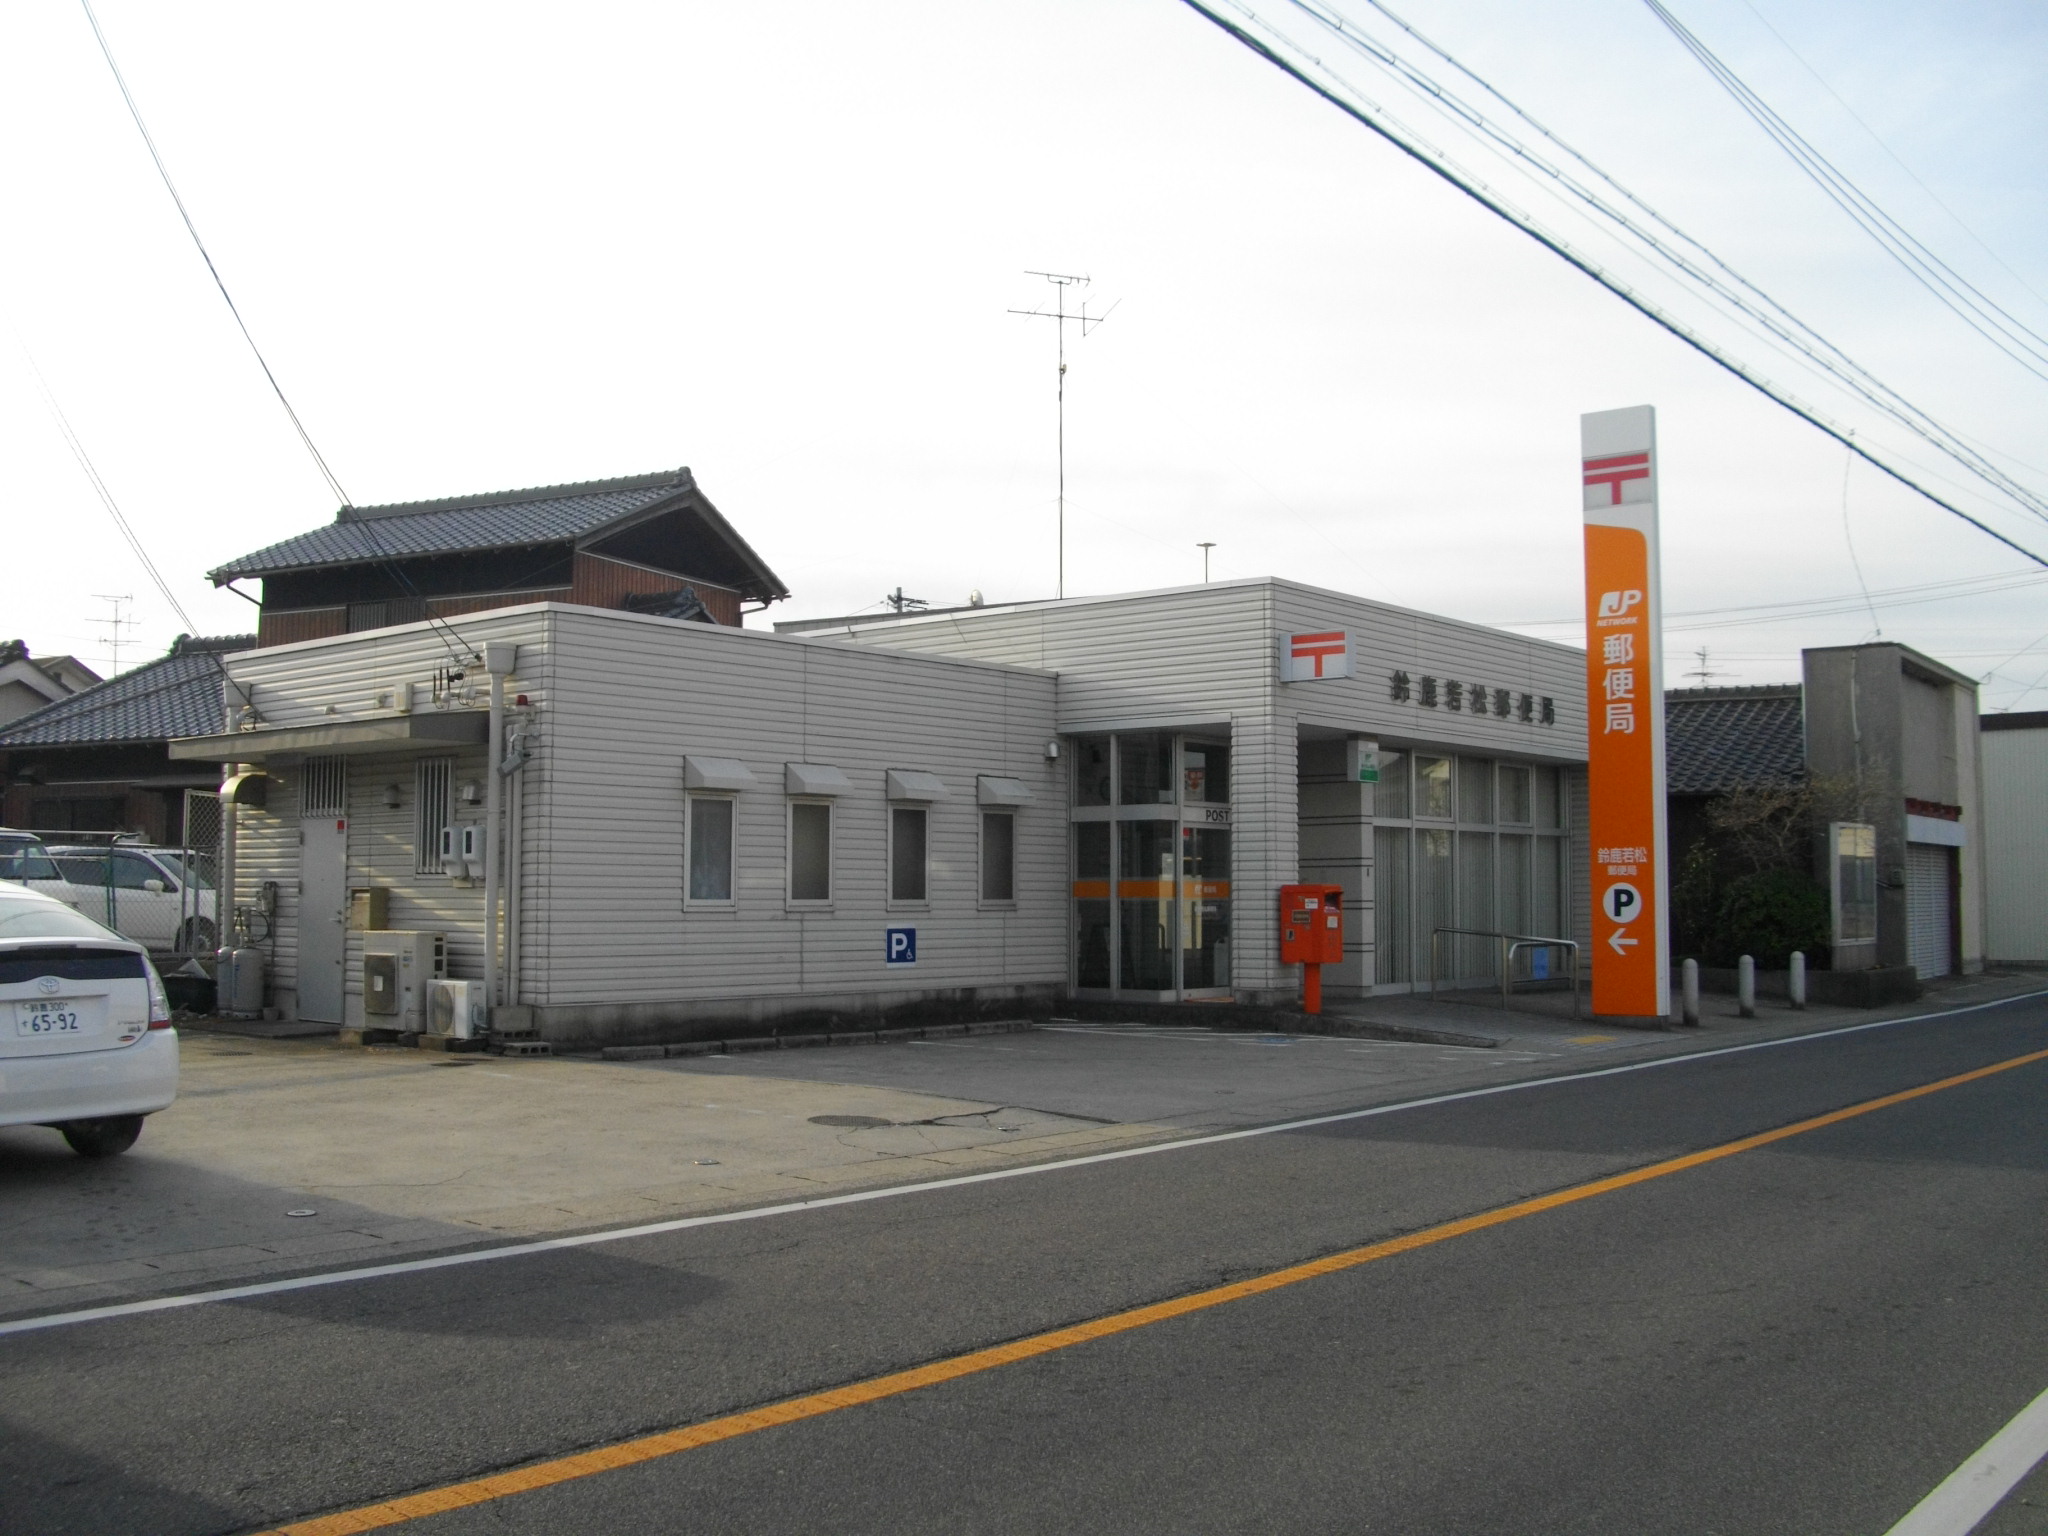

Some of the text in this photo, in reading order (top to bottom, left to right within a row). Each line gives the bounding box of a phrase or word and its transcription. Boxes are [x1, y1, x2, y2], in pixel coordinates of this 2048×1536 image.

[1596, 617, 1638, 627] NETWORK
[1603, 633, 1635, 735] 郵便局
[1389, 669, 1555, 726] 鈴鹿若松郵便局
[1206, 810, 1230, 822] POST
[1597, 847, 1647, 863] 鈴鹿若松
[1607, 865, 1637, 876] 郵便局
[1613, 888, 1635, 917] P
[891, 932, 908, 959] P
[49, 1002, 65, 1011] 300
[32, 1012, 78, 1032] 65-92
